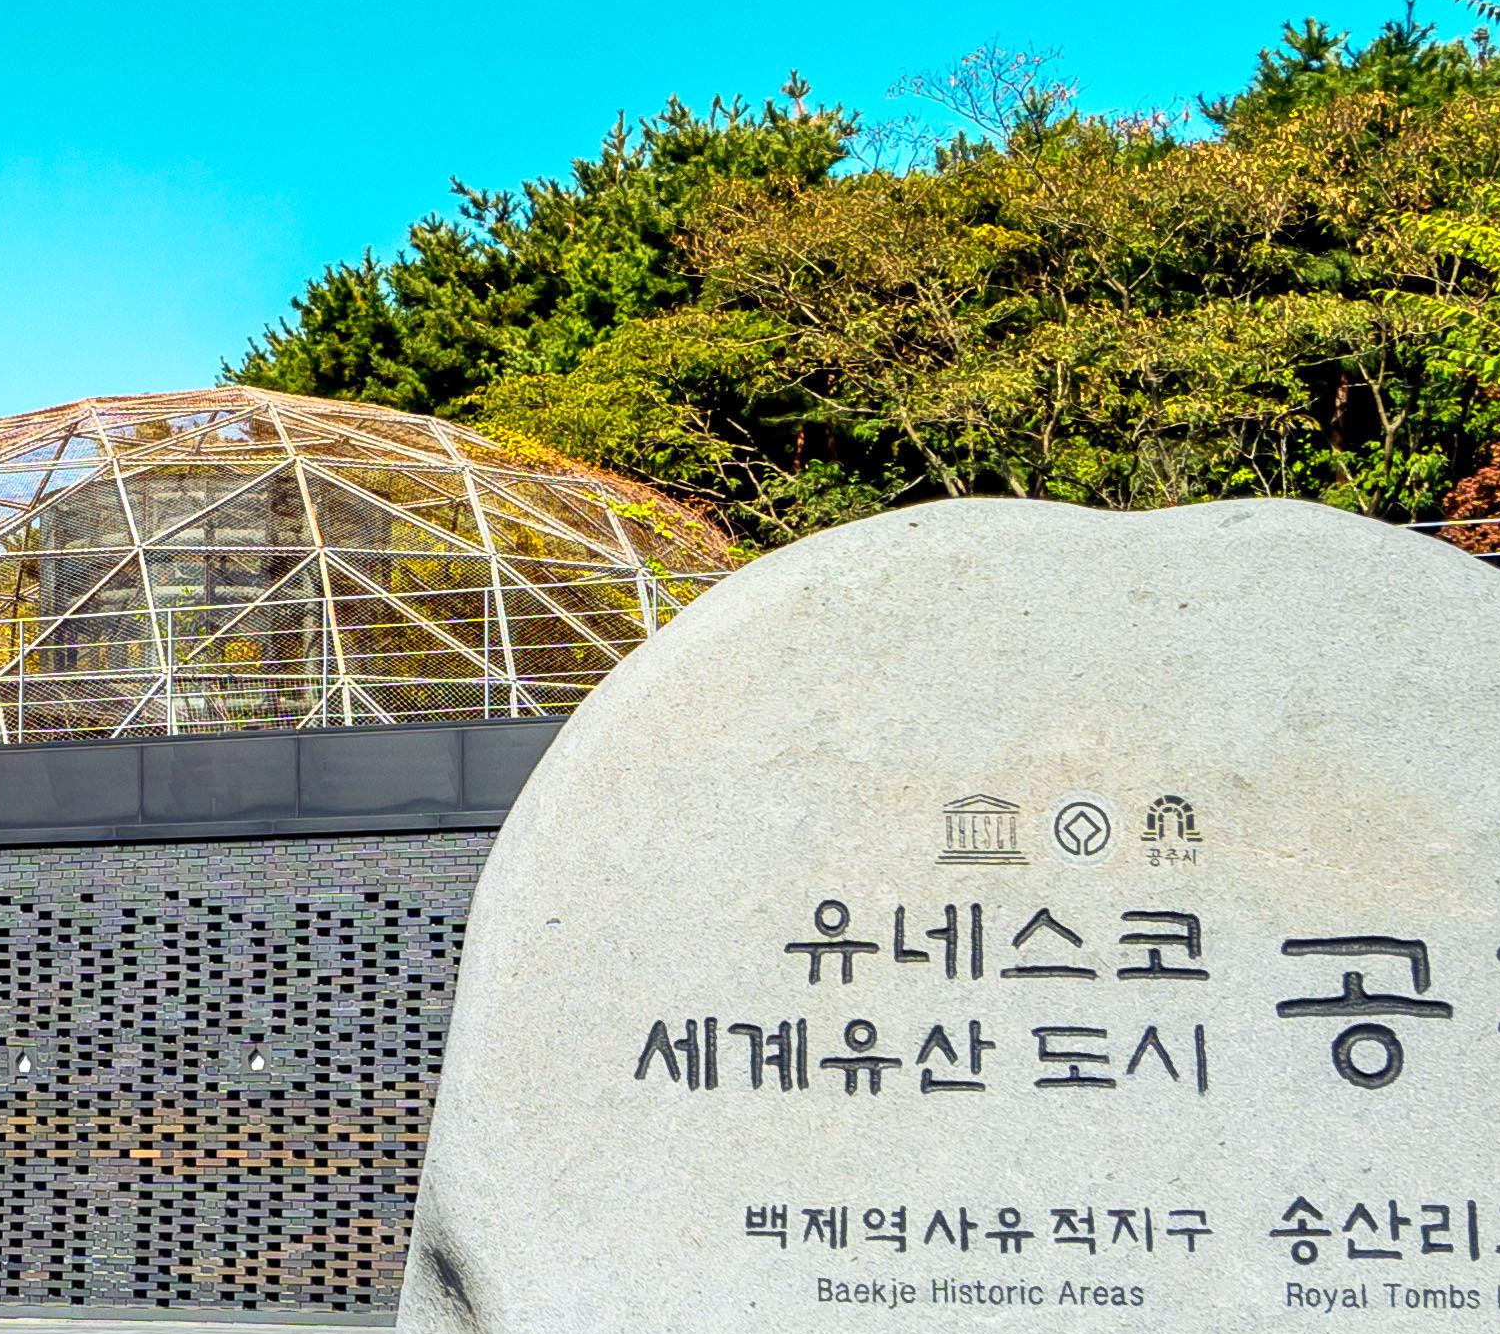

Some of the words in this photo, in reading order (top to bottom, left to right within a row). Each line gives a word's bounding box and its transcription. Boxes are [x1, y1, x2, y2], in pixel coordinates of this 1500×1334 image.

[1146, 848, 1197, 867] 공주시
[784, 899, 1210, 985] 유네스코
[634, 1016, 997, 1095] 세계유산
[1031, 1023, 1209, 1095] 도시
[744, 1204, 1214, 1255] 백제역사유적지구
[817, 1278, 917, 1309] Baekje
[931, 1279, 1044, 1305] Historic
[1058, 1280, 1145, 1307] Areas
[1286, 1282, 1367, 1314] Royal
[1383, 1283, 1481, 1309] Tombs
